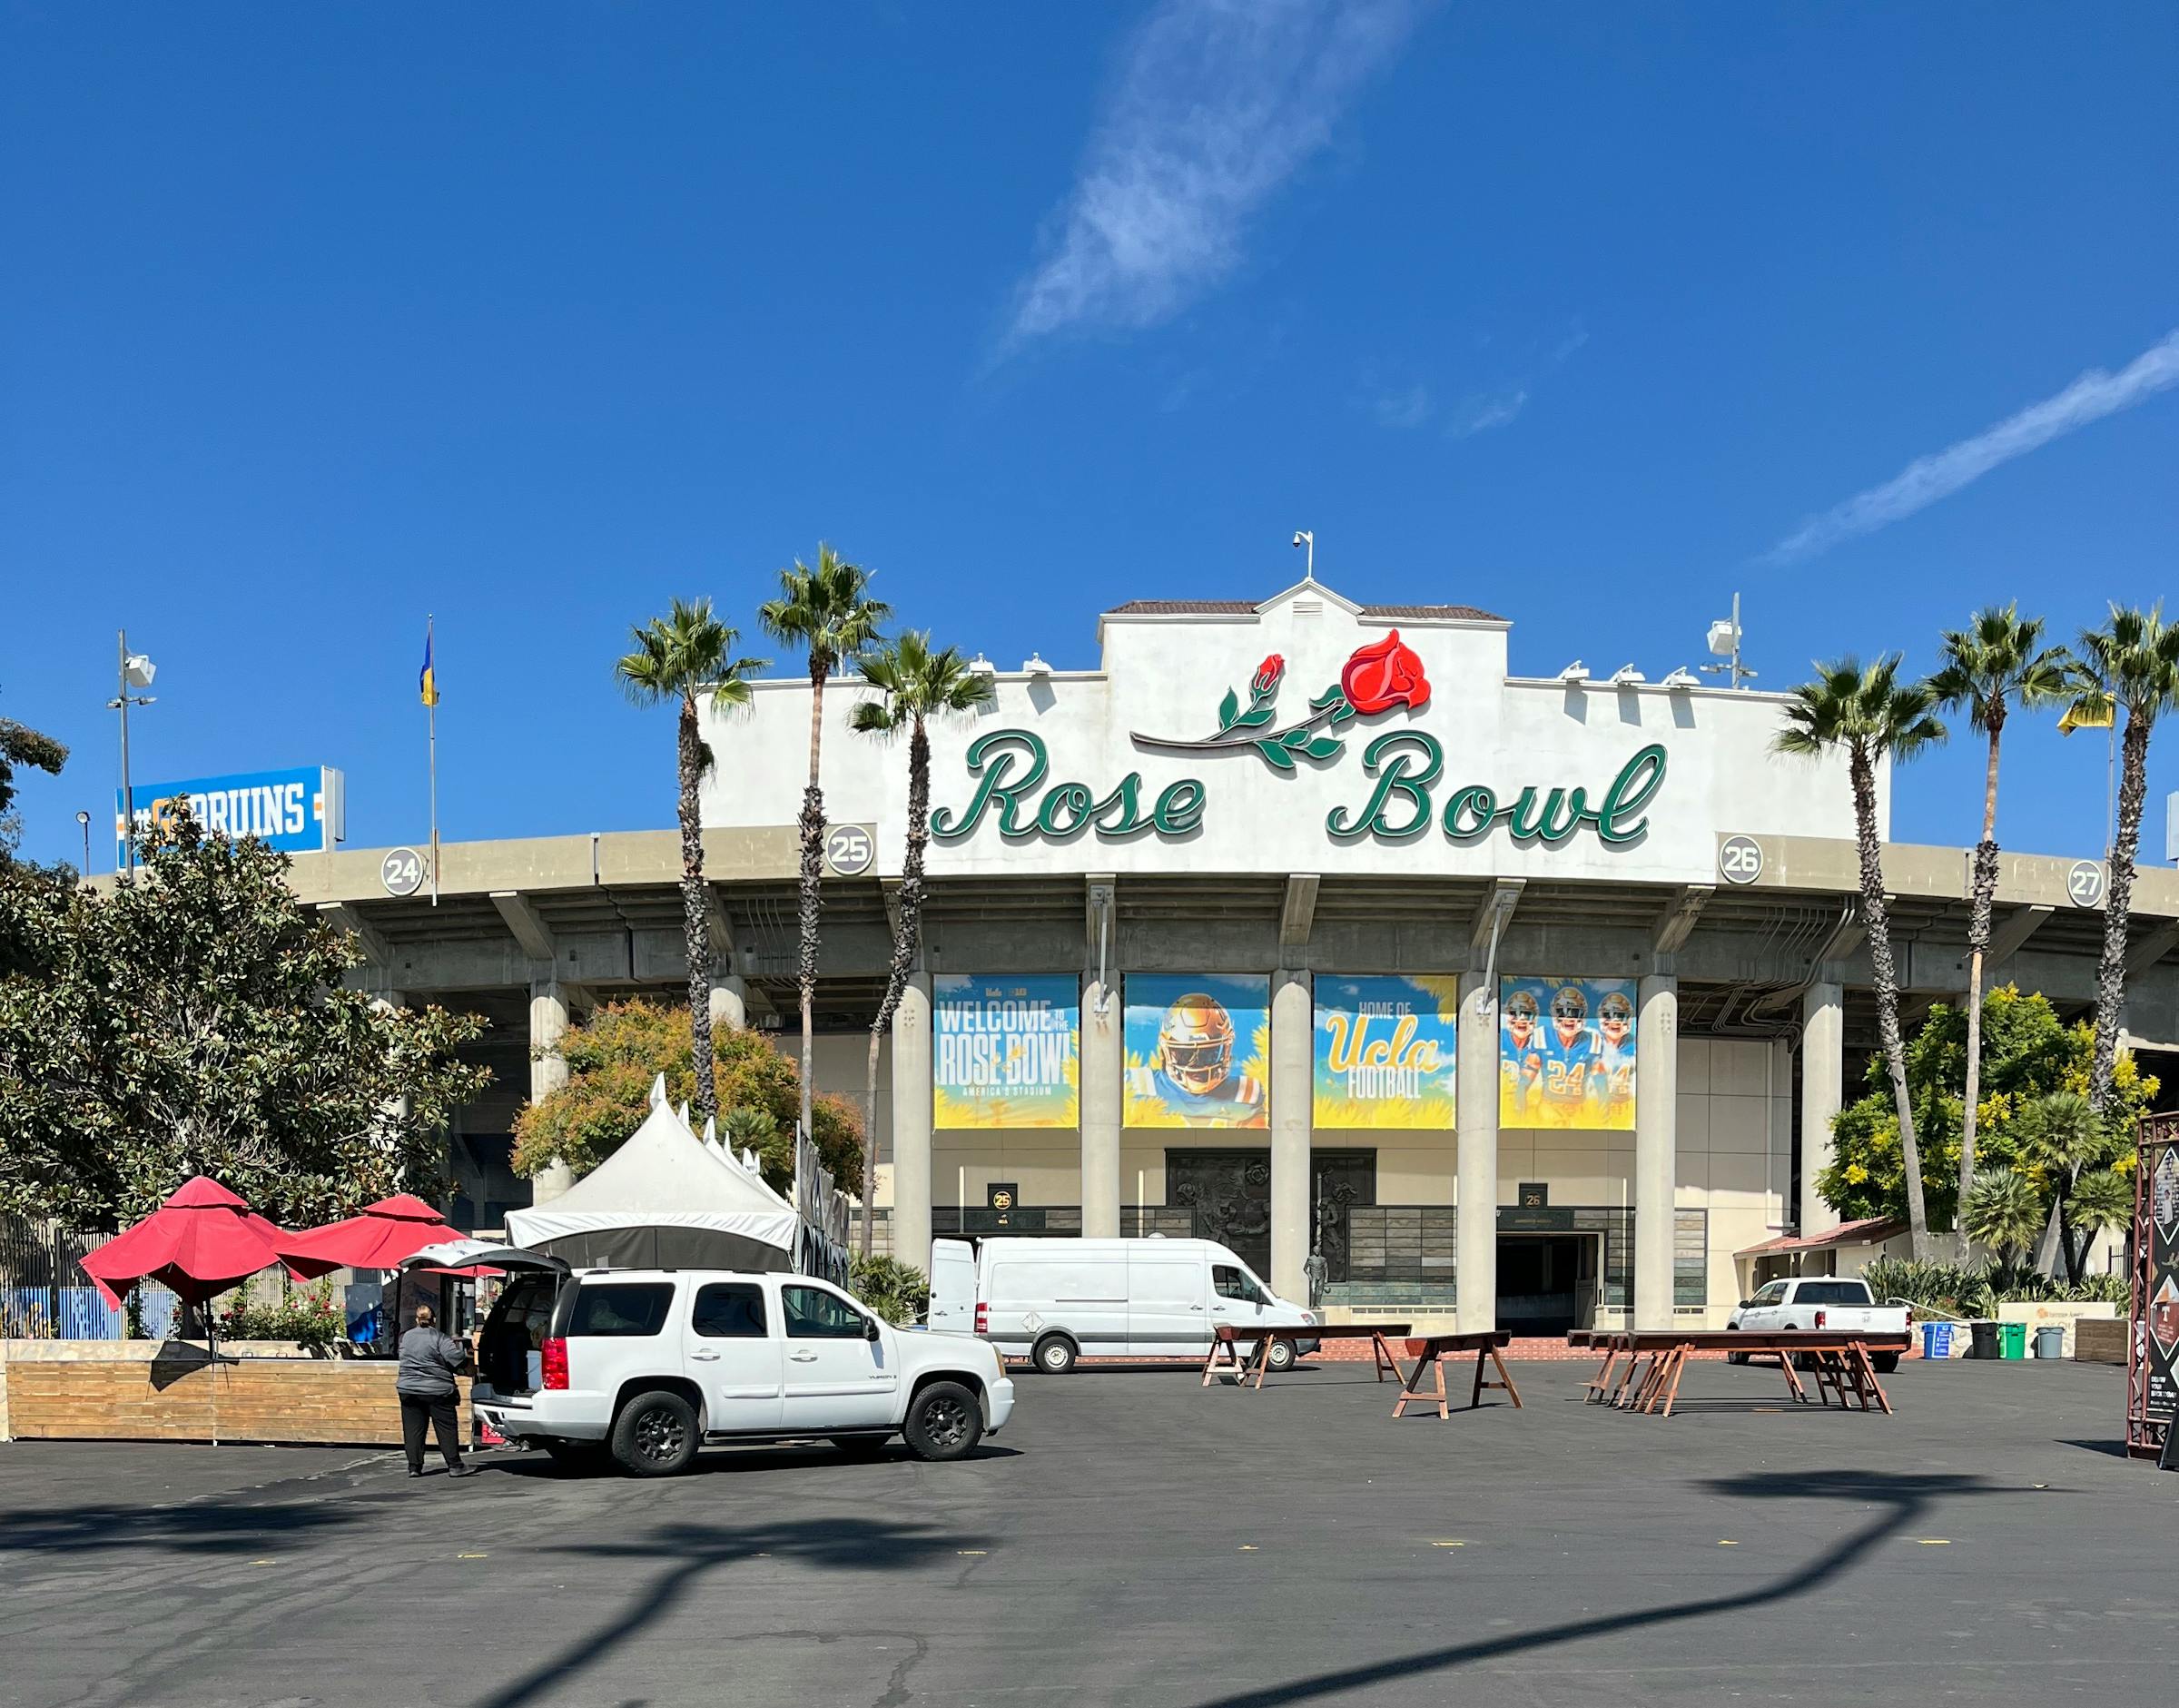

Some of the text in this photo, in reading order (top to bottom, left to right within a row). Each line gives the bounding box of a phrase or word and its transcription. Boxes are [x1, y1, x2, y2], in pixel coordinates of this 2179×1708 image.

[929, 727, 1669, 843] Rose Bowl
[831, 836, 868, 863] 25
[1725, 846, 1759, 872] 26
[386, 858, 419, 884] 24
[2072, 871, 2100, 895] 27
[940, 1000, 1051, 1032] WELCOME
[1054, 1009, 1065, 1021] TO
[1358, 1002, 1412, 1020] HOME OF
[1054, 1021, 1069, 1032] THE
[939, 1033, 1001, 1086] ROSE
[1347, 1065, 1422, 1099] FOOTBALL
[1547, 1060, 1586, 1096] 24
[962, 1086, 1051, 1097] AMERICA'S STADIUM
[995, 1194, 1010, 1206] 25
[1526, 1195, 1541, 1206] 26
